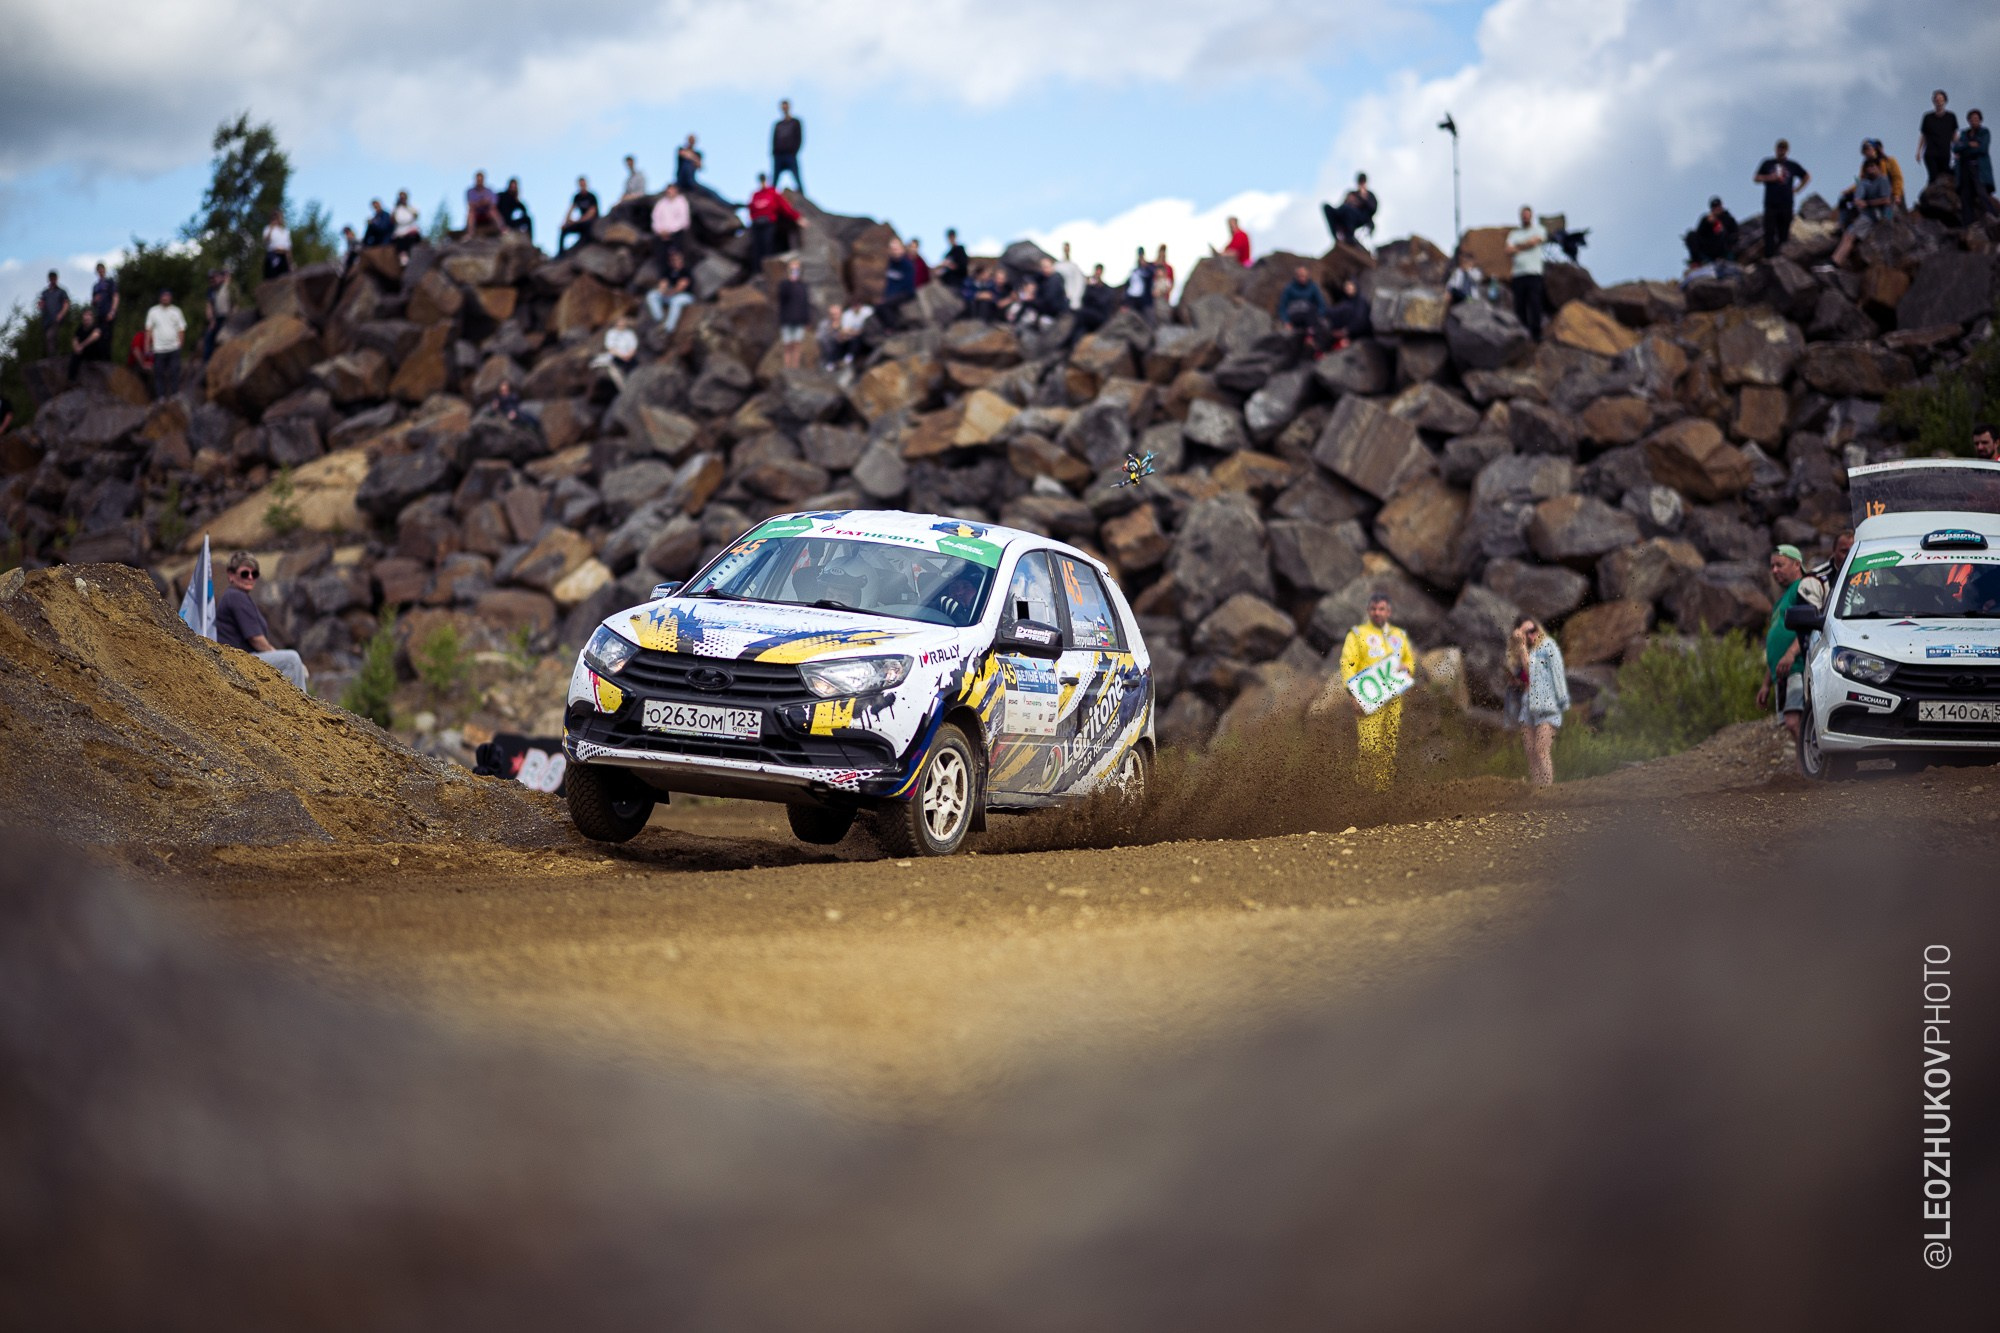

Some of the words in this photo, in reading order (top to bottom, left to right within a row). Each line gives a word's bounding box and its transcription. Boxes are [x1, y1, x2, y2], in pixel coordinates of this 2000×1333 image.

[729, 539, 768, 557] 45
[1060, 559, 1084, 606] 45
[1849, 571, 1872, 587] 41
[1016, 626, 1052, 638] Dynamic
[919, 654, 924, 668] I
[929, 644, 960, 665] RALLY
[1001, 662, 1017, 685] 45
[1016, 669, 1040, 682] БЕЛЫЕ
[1040, 671, 1057, 685] НОЧИ
[1357, 660, 1404, 703] OK
[1858, 694, 1889, 706] YOKOHAMA
[727, 711, 757, 728] 123
[1063, 674, 1124, 774] Loritone
[1077, 752, 1093, 775] CAR
[1093, 713, 1121, 758] REFINISH
